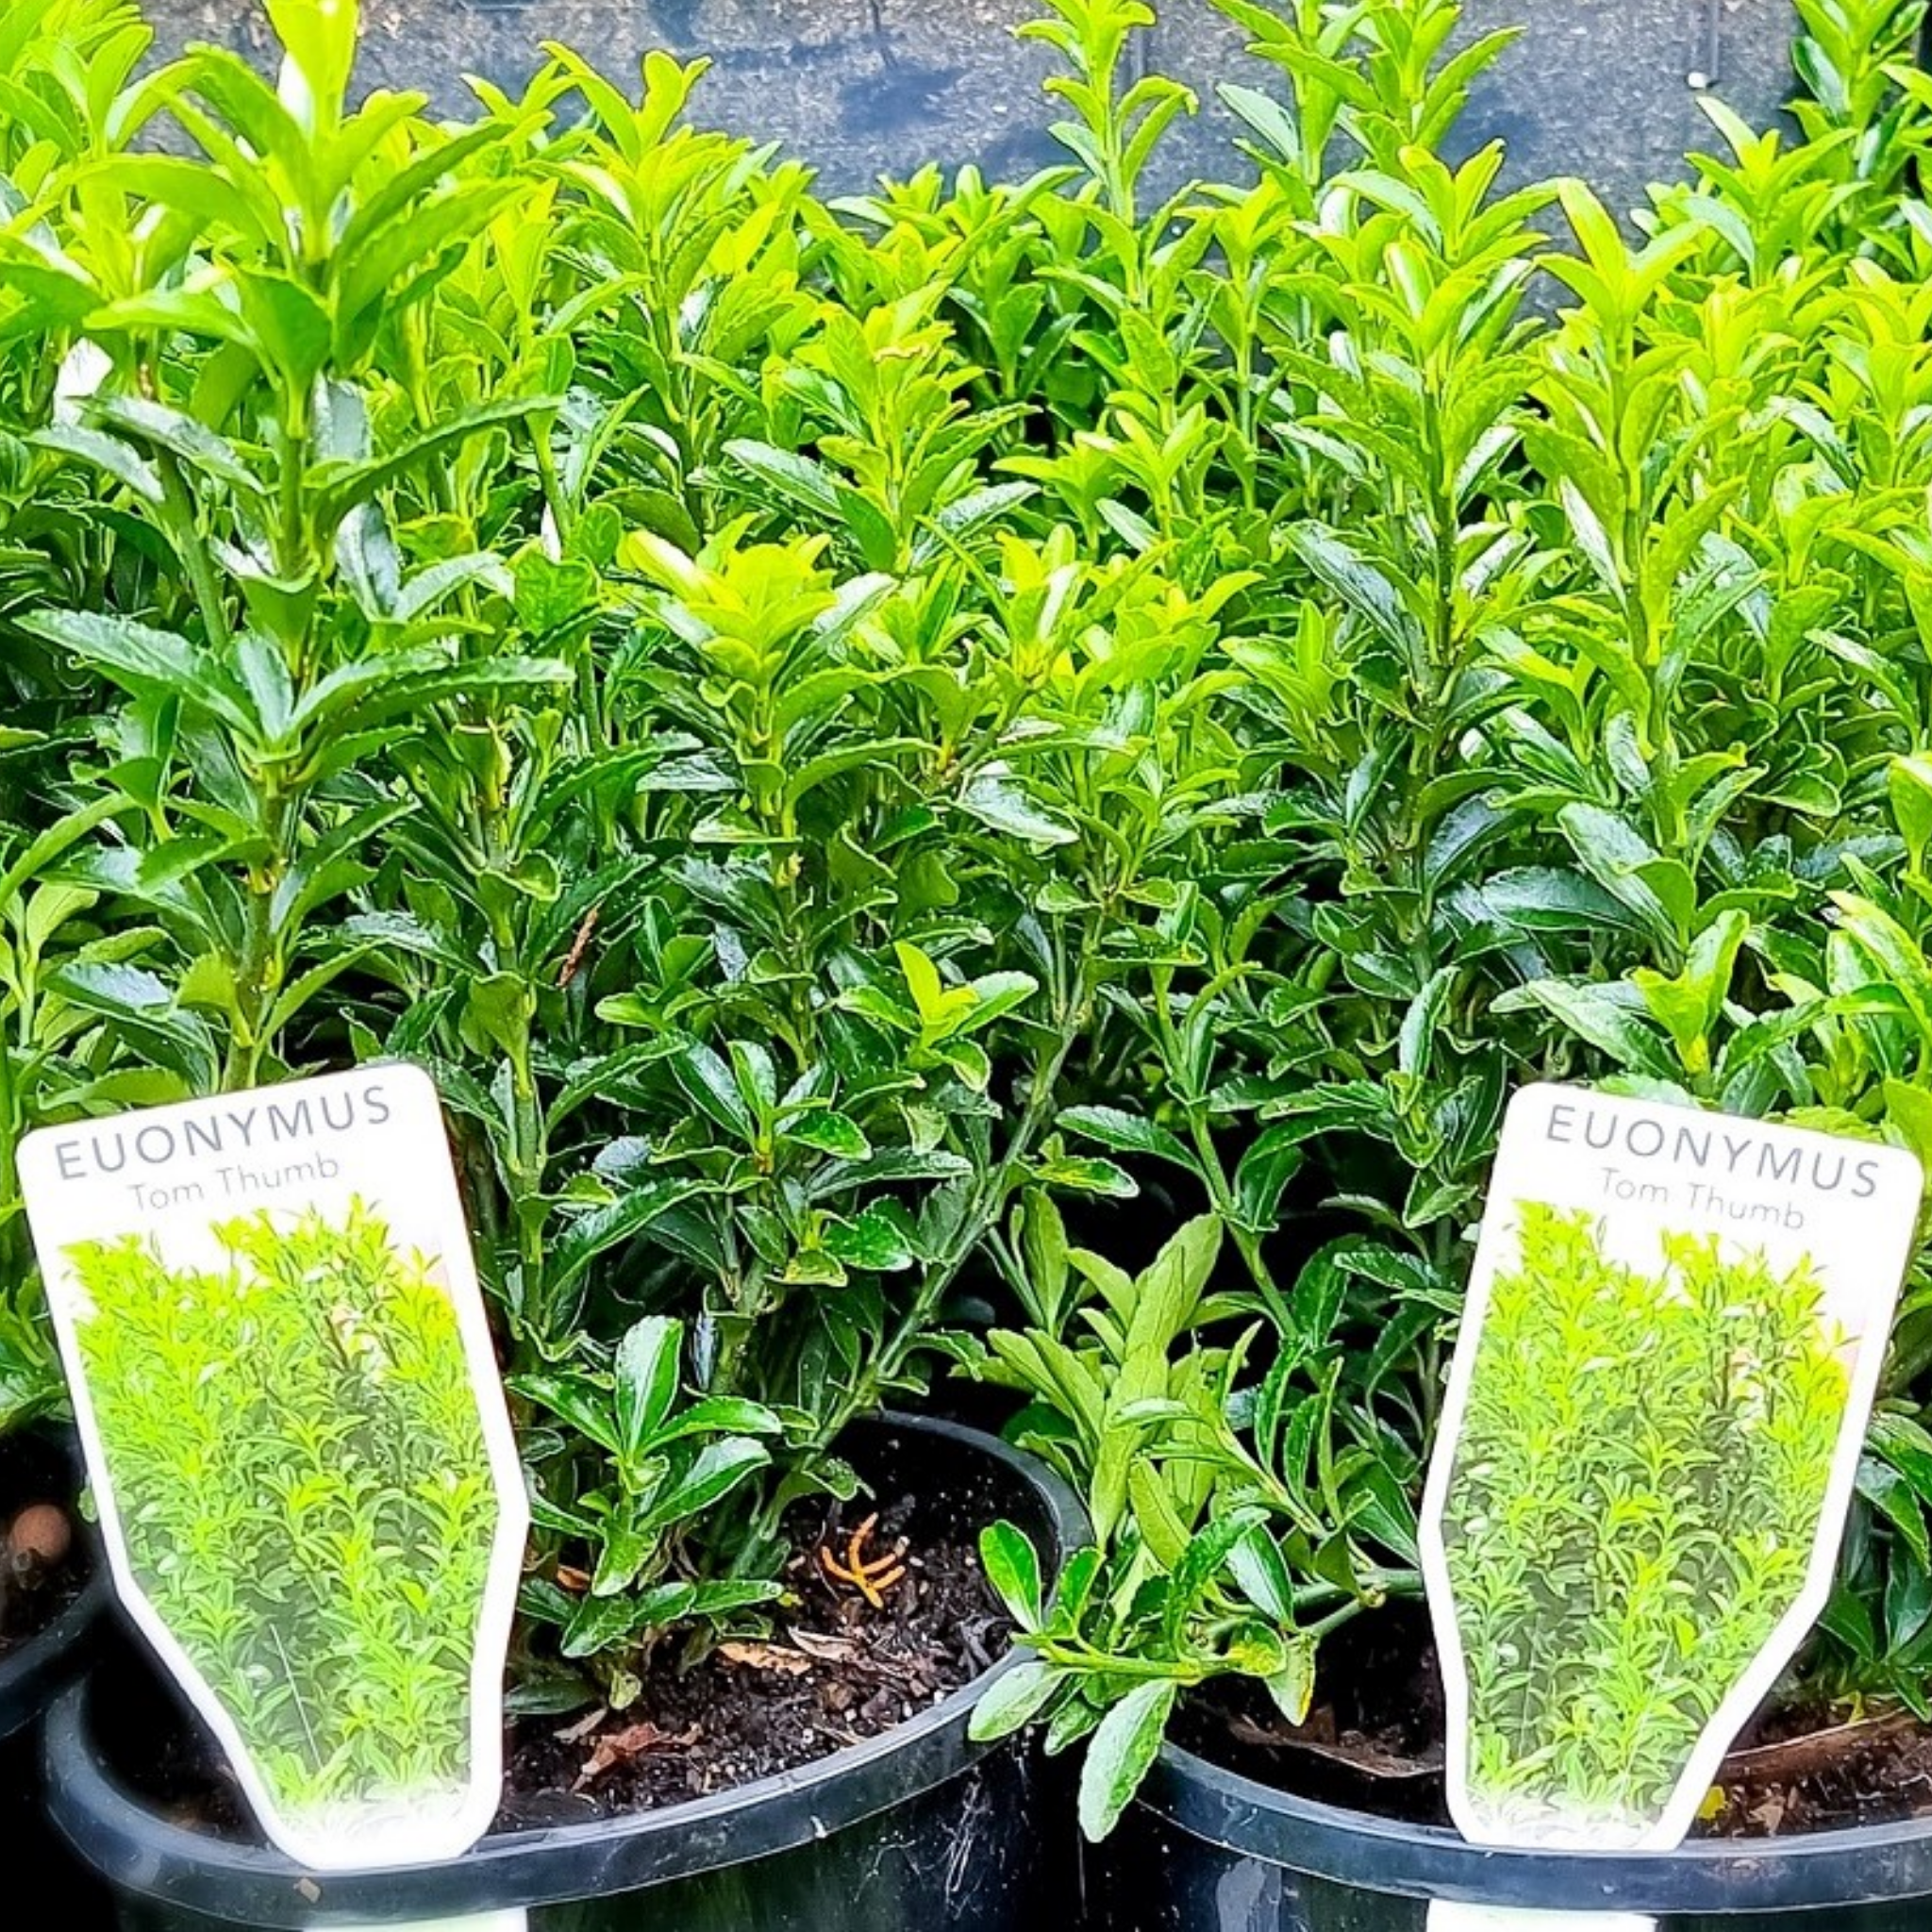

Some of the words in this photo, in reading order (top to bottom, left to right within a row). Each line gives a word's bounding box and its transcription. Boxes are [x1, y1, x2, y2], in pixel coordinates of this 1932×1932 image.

[55, 1086, 390, 1180] EUONYMUS
[1546, 1104, 1880, 1198] EUONYMUS
[127, 1179, 205, 1212] Tom
[216, 1152, 340, 1197] Thumb
[1601, 1167, 1670, 1203] Tom
[1688, 1182, 1805, 1230] Thumb
